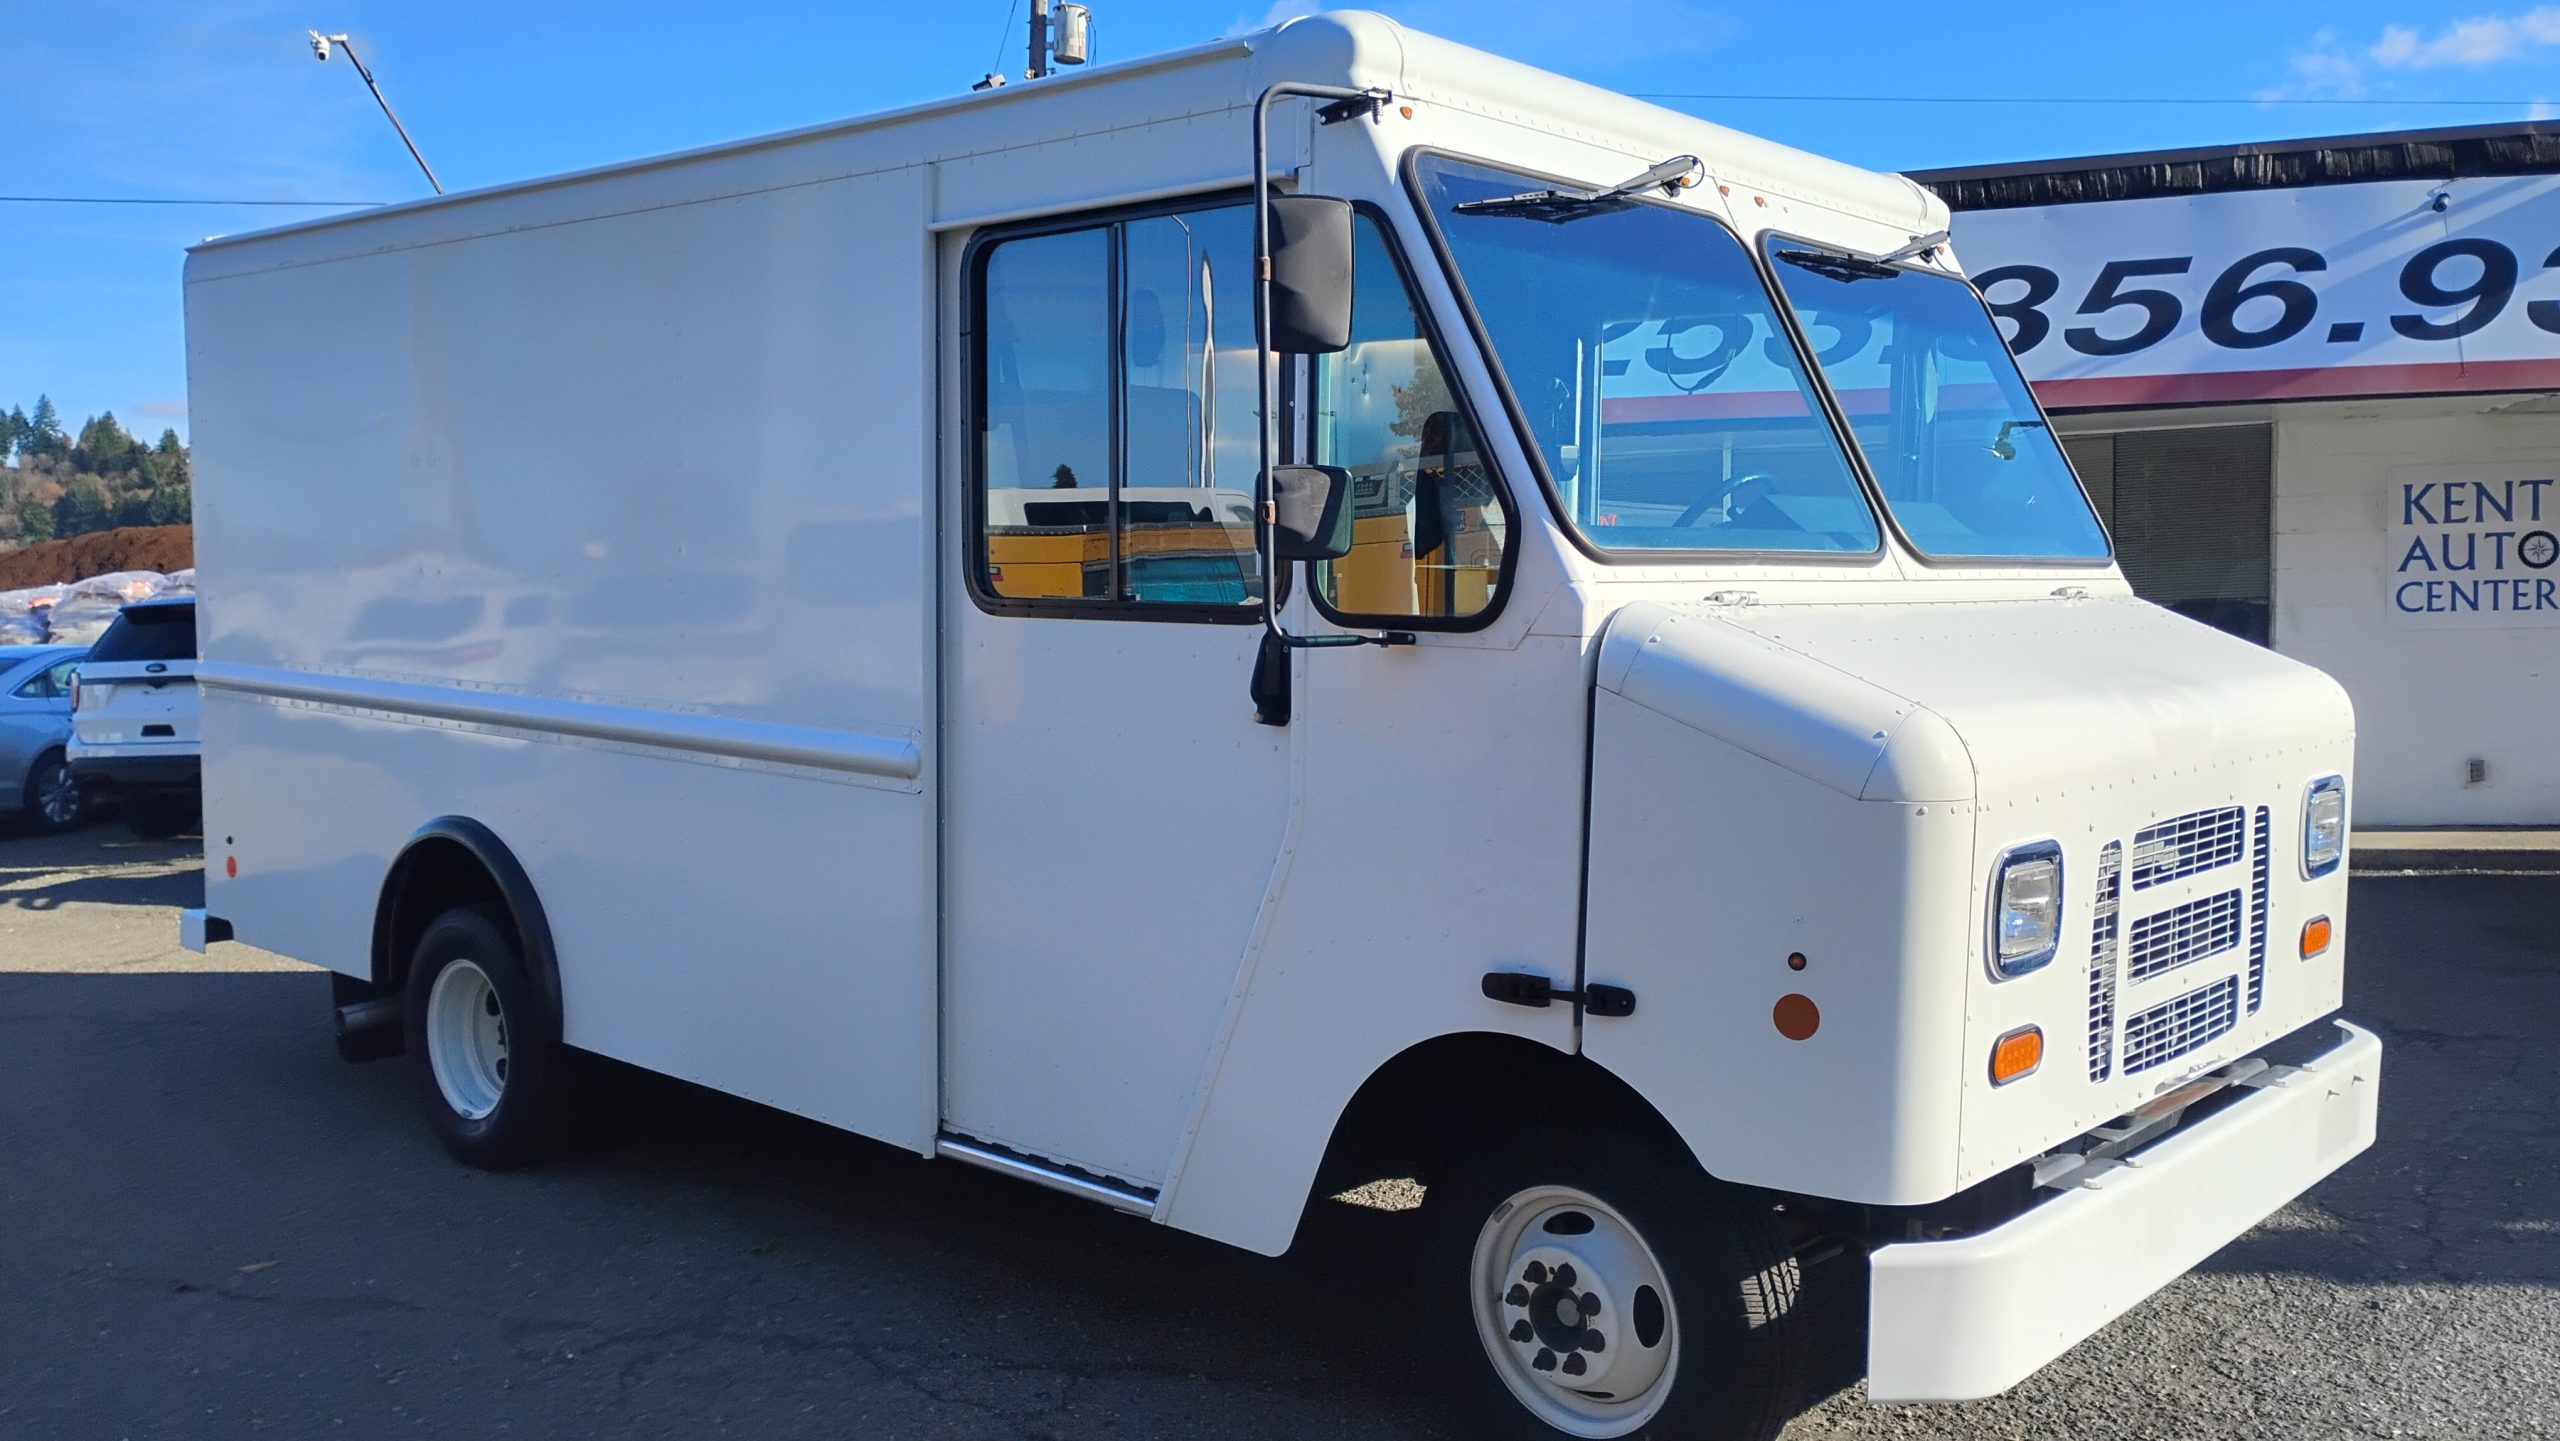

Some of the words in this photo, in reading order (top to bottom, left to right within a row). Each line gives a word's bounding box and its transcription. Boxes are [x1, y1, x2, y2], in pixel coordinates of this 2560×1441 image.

[2403, 479, 2554, 525] KENT
[2397, 530, 2560, 572] AUTO
[2396, 578, 2560, 613] CENTER
